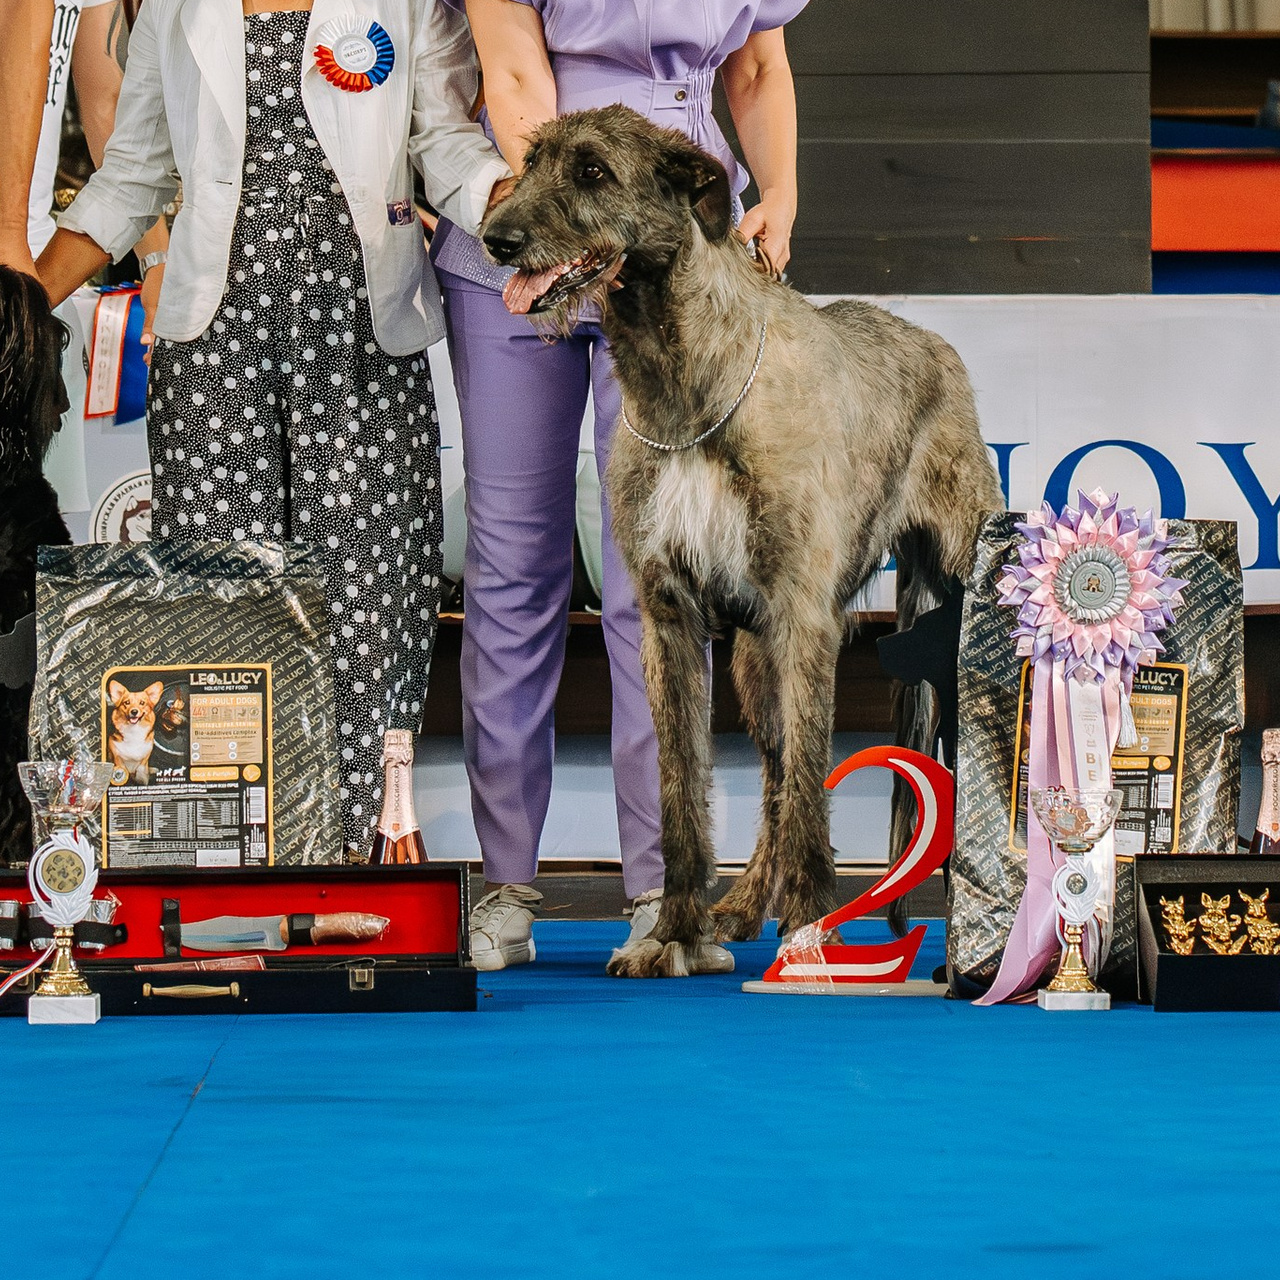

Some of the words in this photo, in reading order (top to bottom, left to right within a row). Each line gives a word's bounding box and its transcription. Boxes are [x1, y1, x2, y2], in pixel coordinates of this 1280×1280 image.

[190, 672, 262, 685] LEO&LUCY
[210, 697, 234, 705] ADULT
[763, 745, 954, 983] 2
